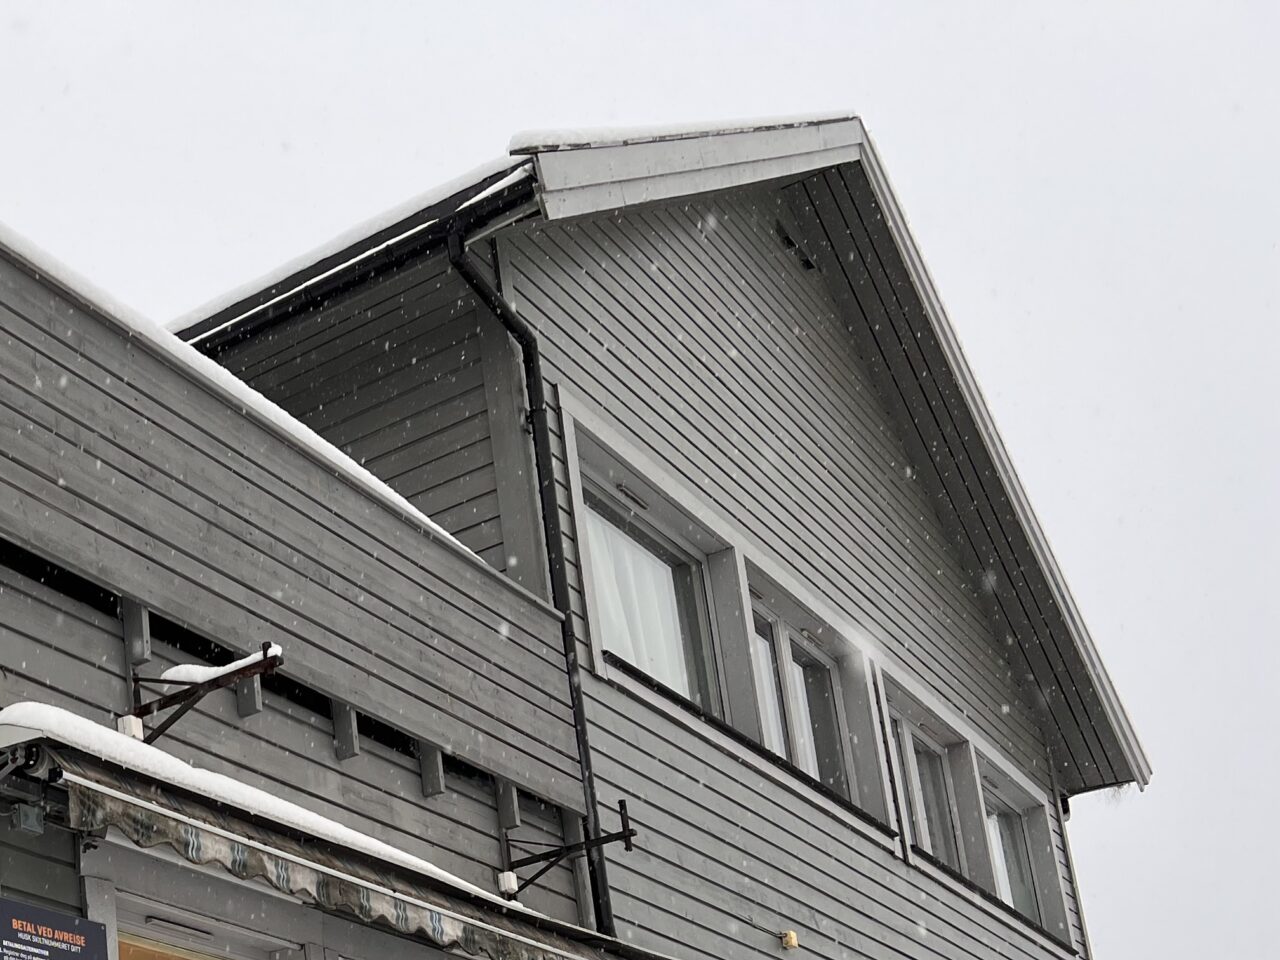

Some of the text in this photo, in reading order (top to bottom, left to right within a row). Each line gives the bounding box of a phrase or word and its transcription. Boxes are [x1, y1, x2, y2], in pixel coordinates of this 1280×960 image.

[12, 919, 85, 946] BETAL VED AVREISE
[18, 932, 30, 941] HUSK
[71, 945, 80, 953] DITT
